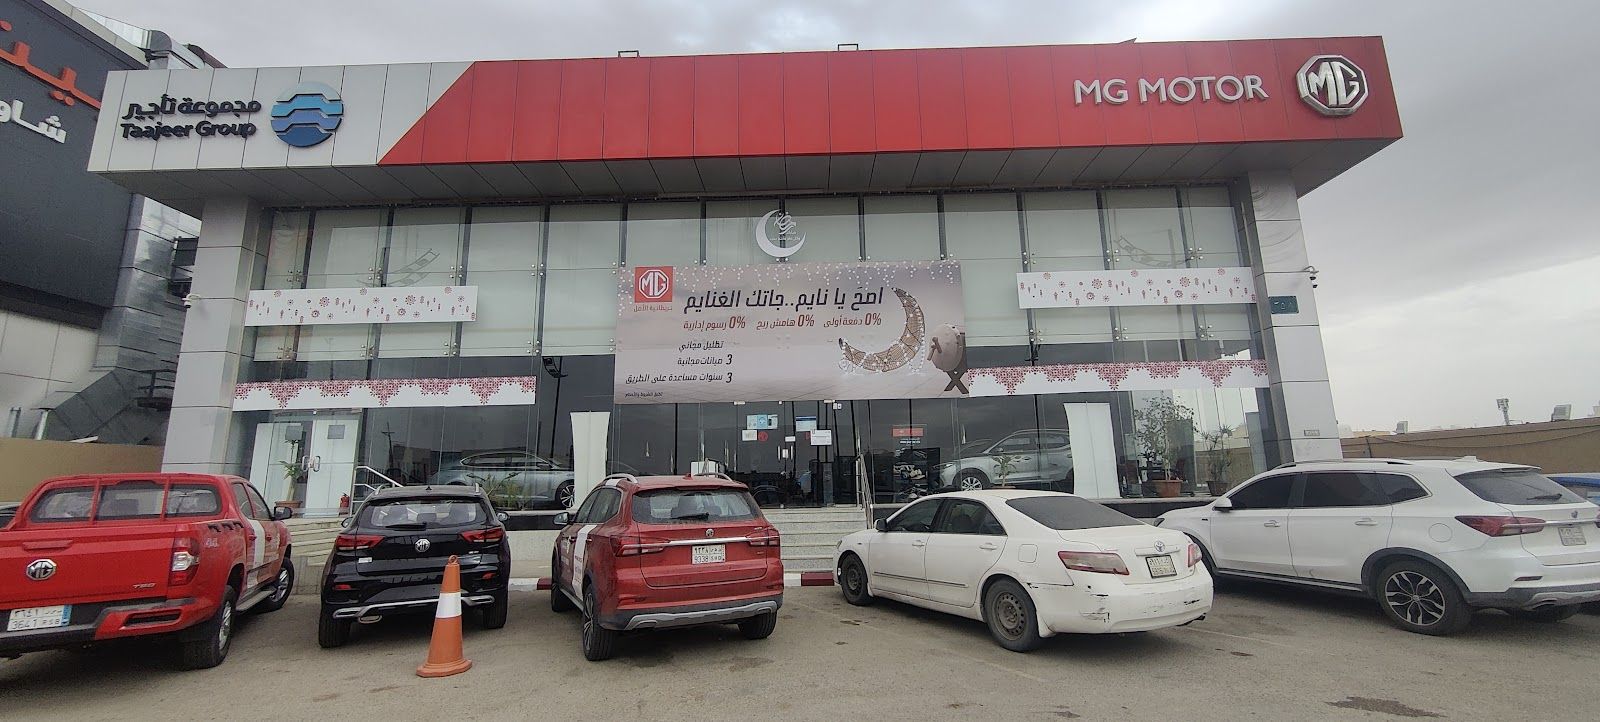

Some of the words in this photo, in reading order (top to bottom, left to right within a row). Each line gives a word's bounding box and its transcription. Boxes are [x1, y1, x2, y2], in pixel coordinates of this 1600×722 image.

[1304, 58, 1362, 108] MG
[1073, 79, 1129, 105] MG
[1138, 74, 1270, 104] MOTOR
[121, 93, 177, 121] تأجير
[178, 97, 262, 119] مجموعة
[120, 121, 194, 141] Taajeer
[195, 120, 257, 139] Group
[641, 271, 667, 297] MG
[683, 289, 742, 315] الغنايم
[833, 287, 846, 310] يا
[705, 321, 727, 331] رسوم
[756, 320, 769, 330] ربح
[770, 317, 796, 329] هامش
[843, 317, 863, 326] دفعة
[678, 340, 702, 352] مجاني
[725, 353, 733, 365] 3
[625, 373, 650, 384] الطريق
[651, 373, 667, 384] على
[668, 373, 698, 382] مساعدة
[699, 373, 723, 382] سنوات
[725, 372, 733, 383] 3
[28, 560, 56, 579] MG
